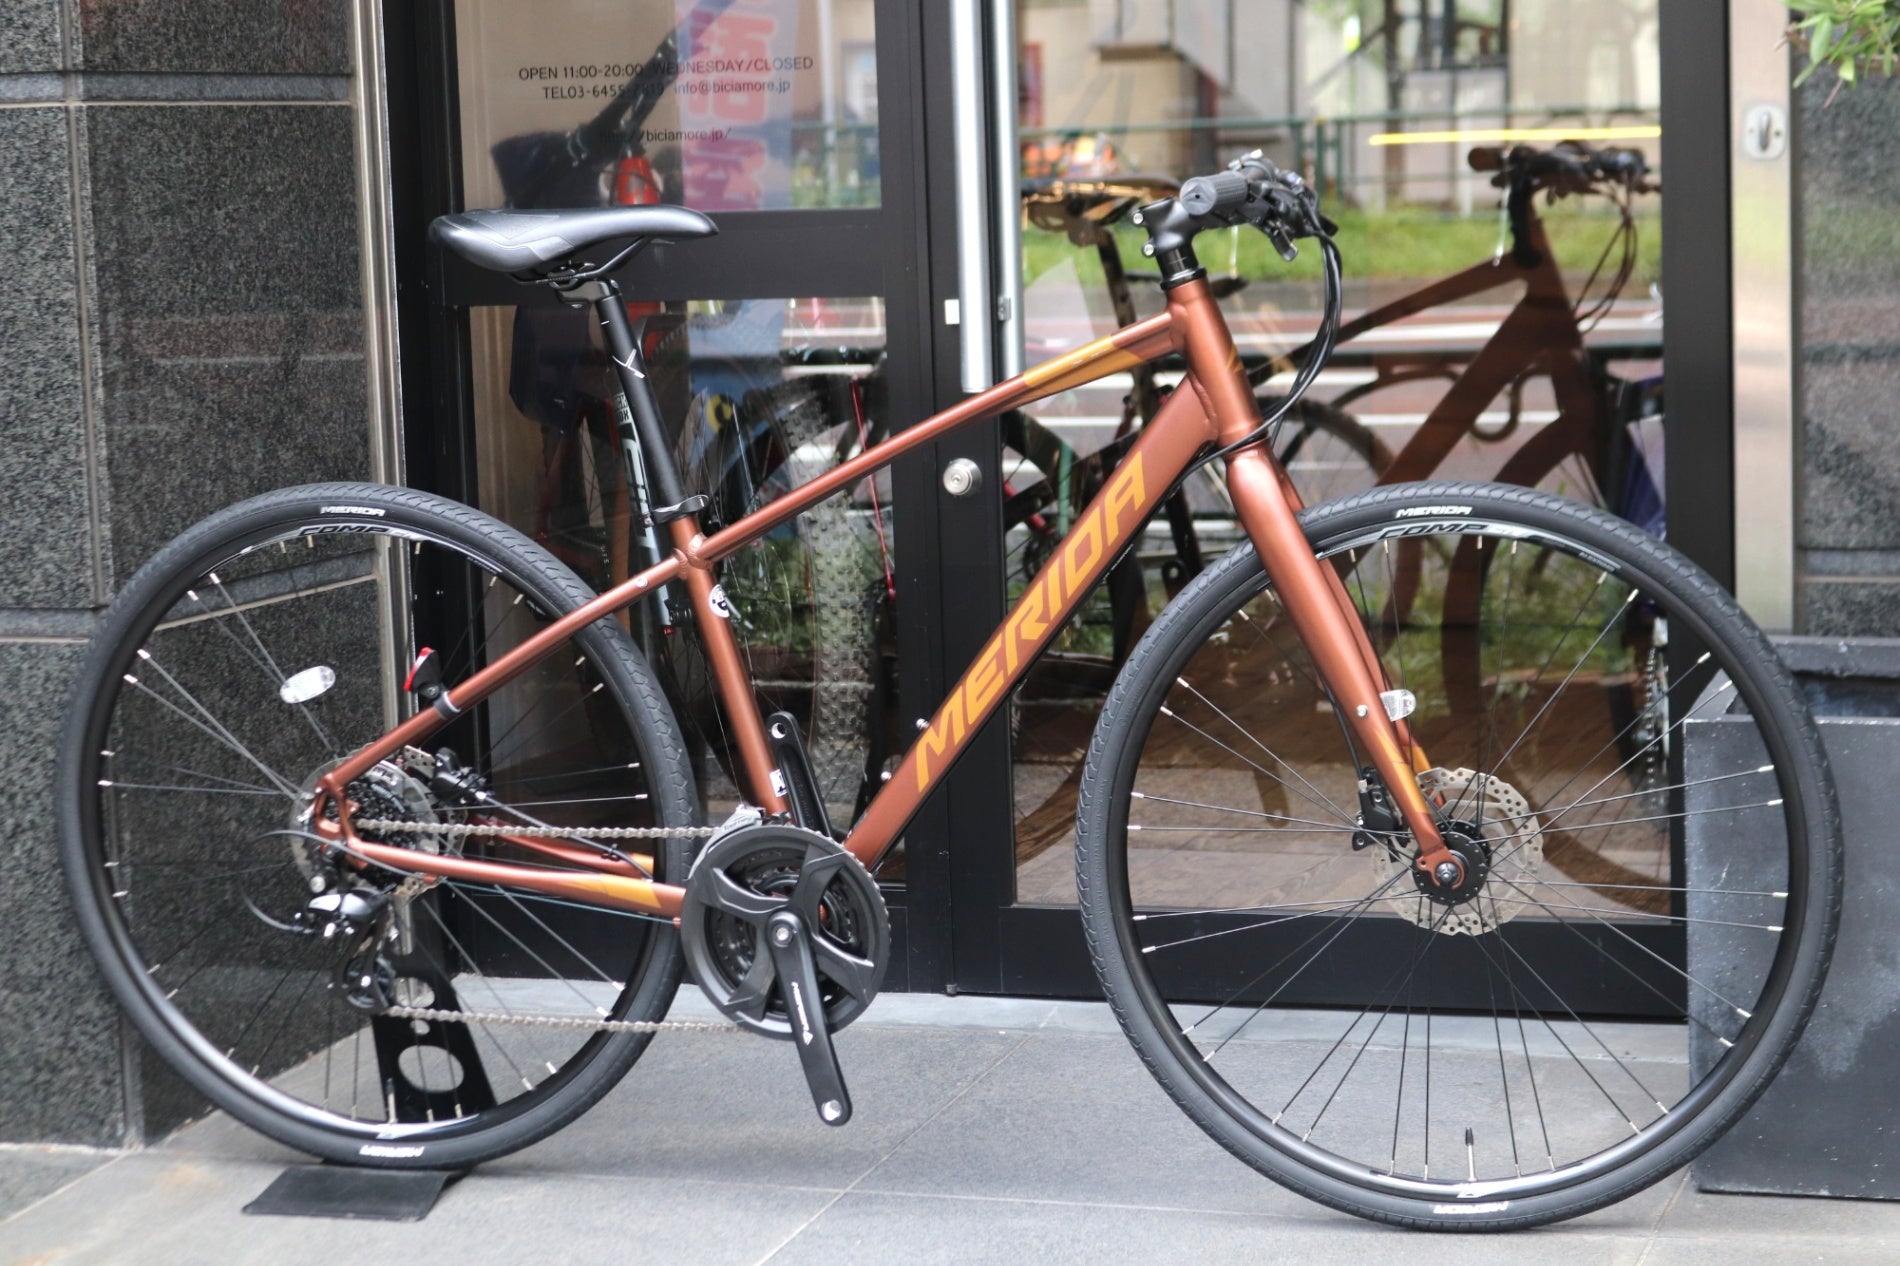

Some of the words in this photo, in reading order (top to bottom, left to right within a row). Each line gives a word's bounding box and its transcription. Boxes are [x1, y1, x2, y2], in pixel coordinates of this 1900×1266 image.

[518, 67, 558, 81] OPEN
[563, 63, 644, 79] 11:00-20:00
[655, 56, 814, 75] WEDNESDAY/CLOSED
[675, 79, 791, 96] info@biciamore.jp
[320, 505, 386, 517] MERIDA
[1395, 505, 1473, 519] MERIDA
[299, 525, 390, 536] COMP
[1380, 523, 1488, 539] COMP
[914, 450, 1147, 793] MERIDA
